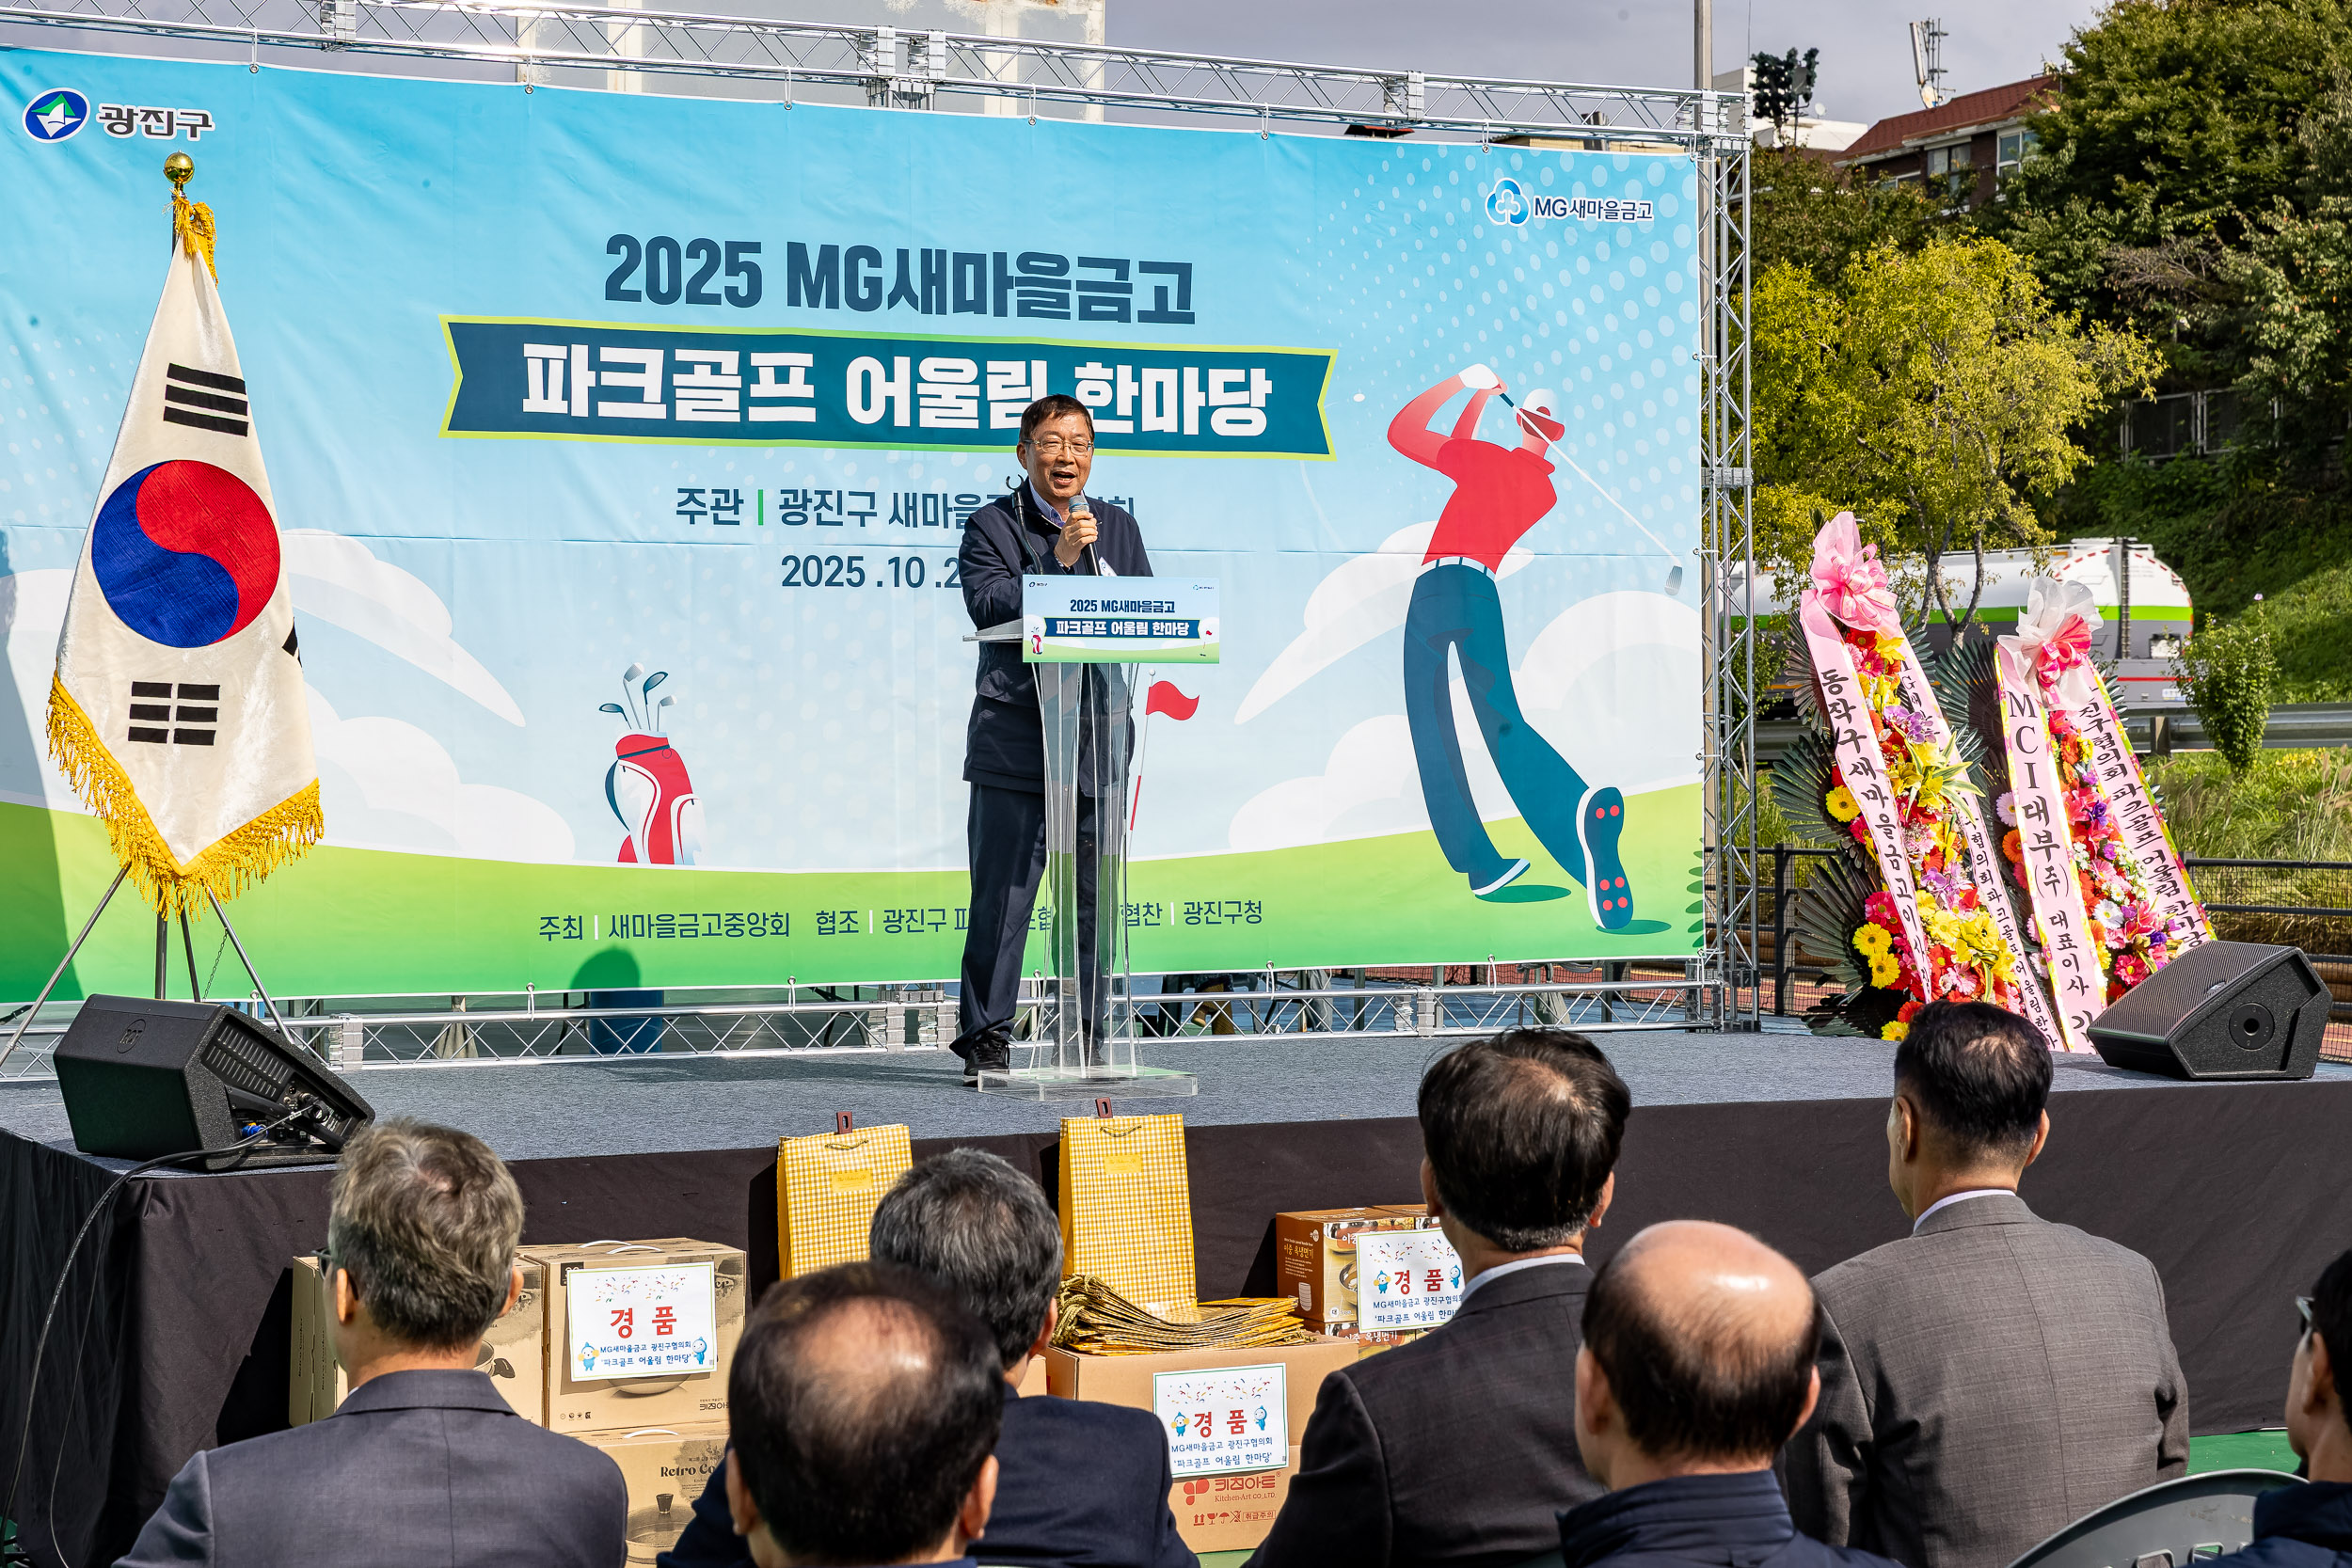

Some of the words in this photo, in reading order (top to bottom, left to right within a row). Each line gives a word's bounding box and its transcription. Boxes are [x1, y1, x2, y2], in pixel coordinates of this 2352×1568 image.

[99, 105, 213, 139] 광진구
[1534, 198, 1652, 220] MG새마을금고
[605, 234, 763, 309] 2025
[787, 243, 1195, 325] MG새마을금고
[522, 341, 816, 422] 파크골프
[846, 355, 1048, 430] 어울림
[1074, 361, 1272, 437] 한마당
[675, 487, 744, 526] 주관
[778, 489, 878, 528] 광진구
[781, 554, 866, 588] 2025
[1070, 599, 1098, 612] 2025
[1101, 600, 1176, 613] MG새마을금고
[1056, 620, 1107, 635] 파크골프
[1111, 621, 1148, 636] 어울림
[1152, 622, 1189, 637] 한마당
[2079, 687, 2128, 782] 진구협의회
[1120, 901, 1163, 927] 협찬
[1183, 899, 1263, 925] 광진구청
[539, 915, 583, 942] 주최
[609, 911, 789, 939] 새마을금고중앙회
[816, 909, 859, 936] 협조
[882, 908, 946, 934] 광진구
[1373, 1298, 1420, 1308] MG새마을금고
[1414, 1311, 1435, 1322] 어울림
[599, 1343, 647, 1354] MG새마을금고
[650, 1340, 691, 1352] 광진구협의회
[638, 1355, 661, 1366] 어울림
[1171, 1441, 1224, 1452] MG새마을금고
[1227, 1436, 1273, 1450] 광진구협의회
[1215, 1455, 1240, 1466] 어울림
[660, 1465, 696, 1478] Retro
[699, 1464, 716, 1475] Co
[1214, 1475, 1276, 1492] 키친아트
[1214, 1493, 1251, 1503] Kitchen-Art
[1245, 1511, 1275, 1520] 취급주의
